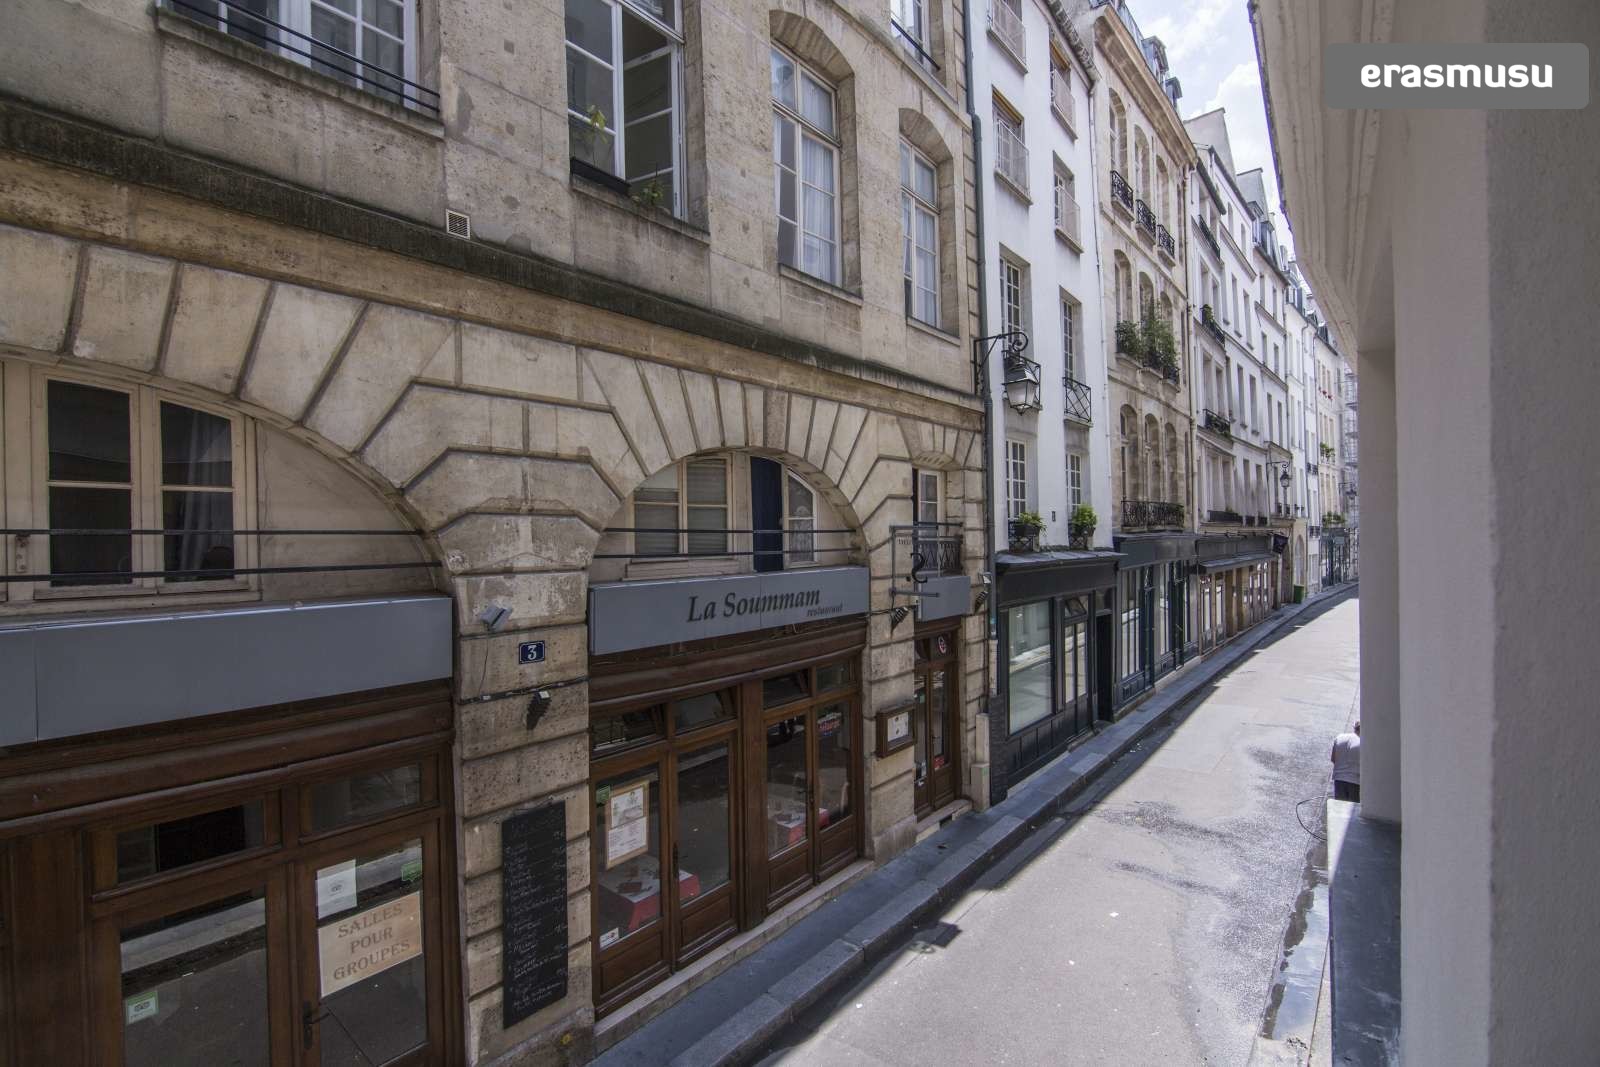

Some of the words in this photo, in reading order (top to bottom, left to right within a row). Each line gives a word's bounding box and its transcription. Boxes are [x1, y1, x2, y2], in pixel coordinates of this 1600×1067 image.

[687, 595, 716, 622] La
[723, 589, 820, 617] Soummam
[527, 644, 537, 660] 3
[338, 903, 403, 938] SALLES
[350, 927, 393, 954] POUR
[333, 940, 410, 980] GROUPES
